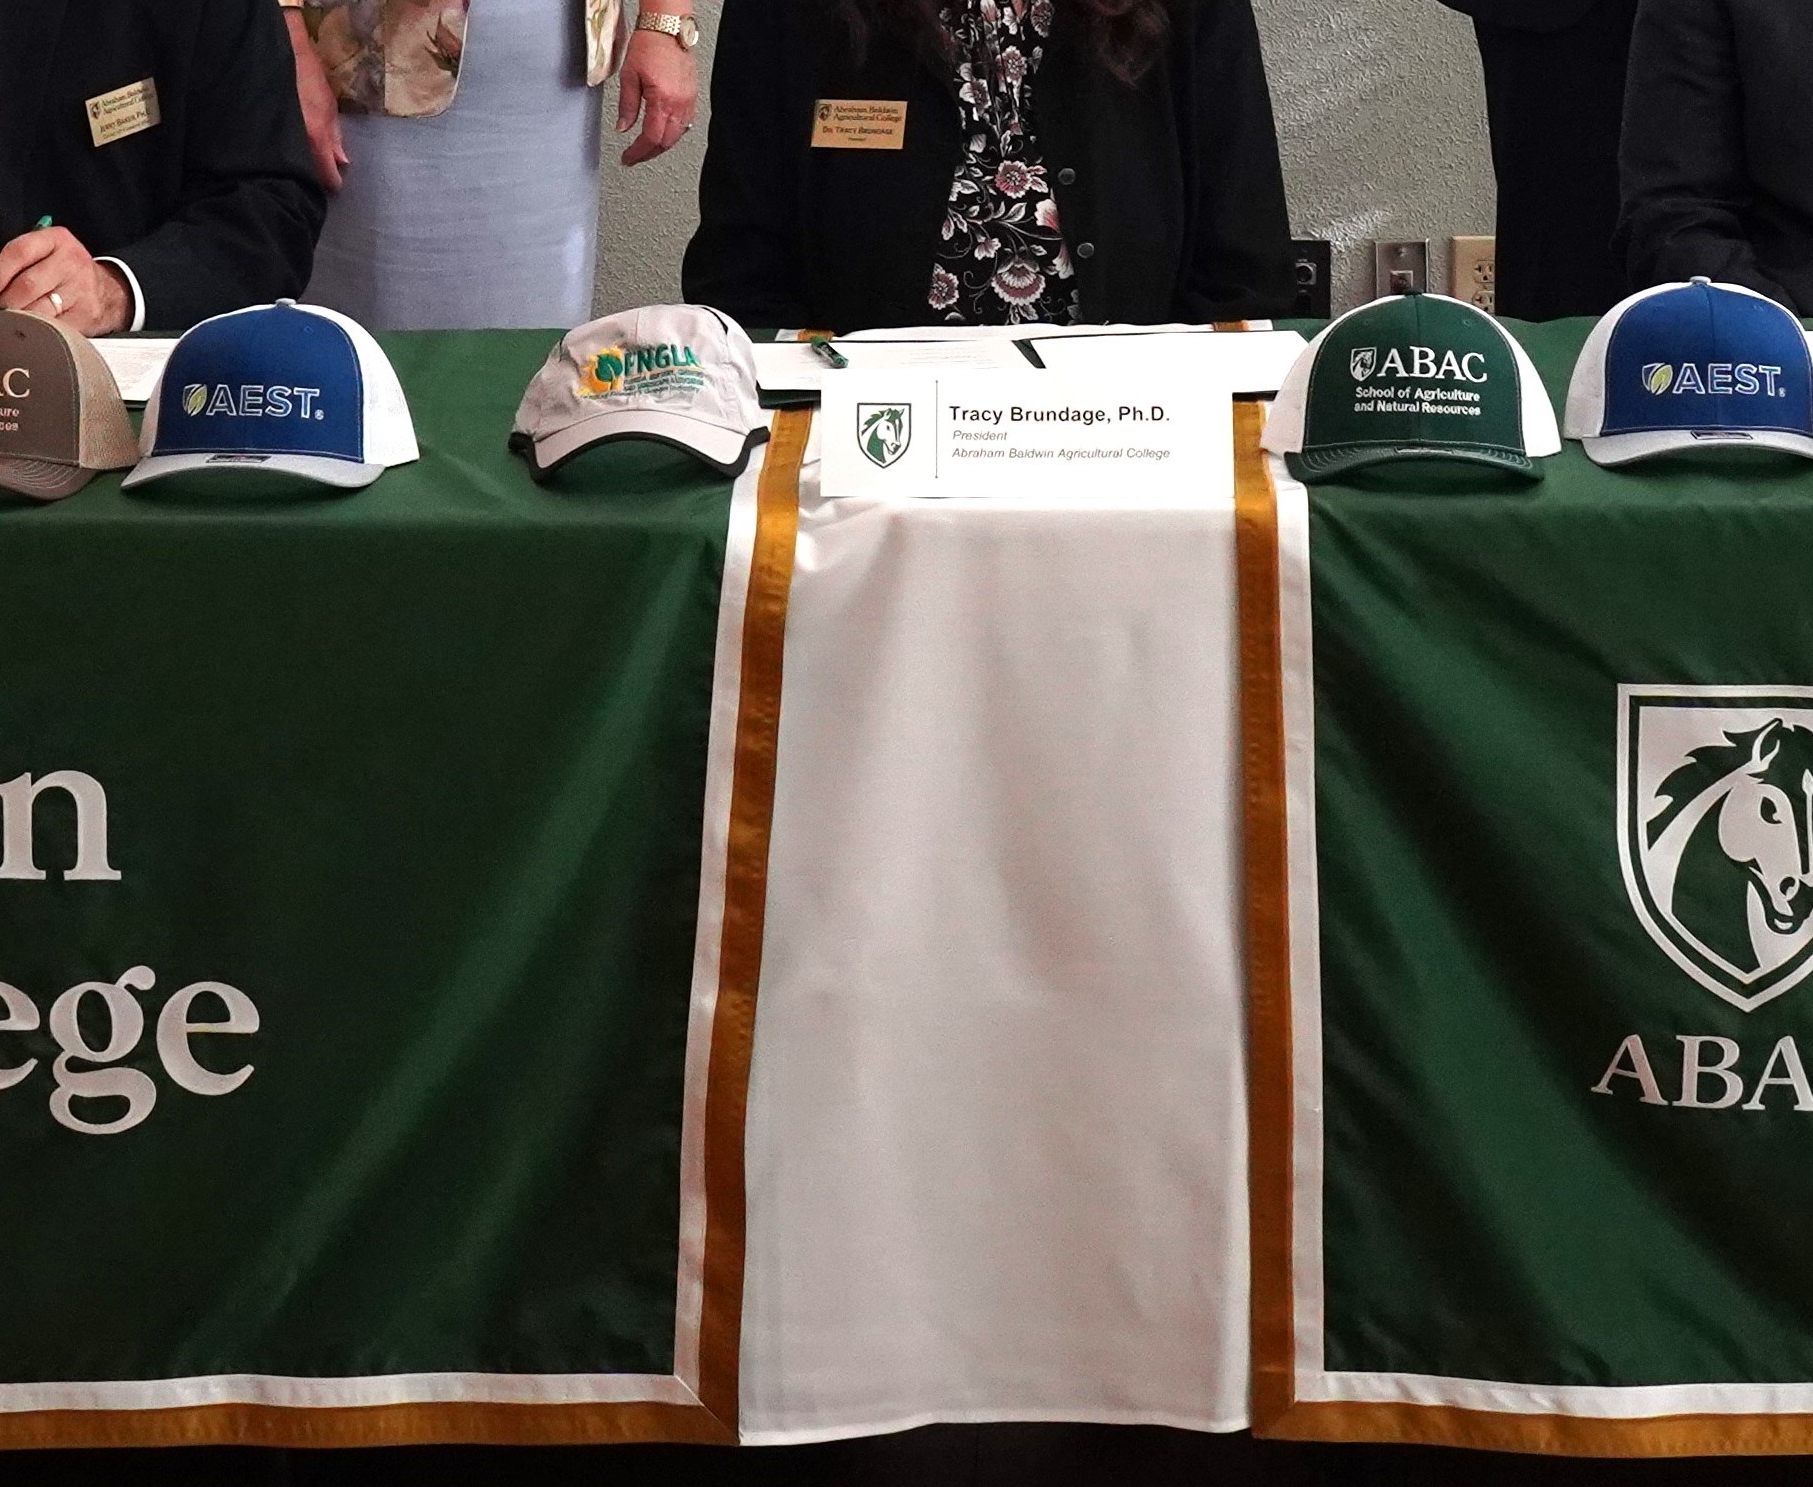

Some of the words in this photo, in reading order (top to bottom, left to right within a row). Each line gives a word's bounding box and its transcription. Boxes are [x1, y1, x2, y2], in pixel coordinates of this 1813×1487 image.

[1377, 345, 1487, 383] ABAC
[1355, 386, 1394, 399] School
[1398, 386, 1411, 398] of
[1414, 387, 1480, 402] Agriculture
[949, 406, 1003, 425] Tracy
[1011, 406, 1111, 426] Brundage,
[1119, 406, 1170, 422] Ph.D.
[1354, 401, 1374, 412] and
[1377, 400, 1419, 412] Natural
[1421, 401, 1481, 416] Resources
[952, 429, 1008, 441] President
[952, 448, 1005, 459] Abraham
[1009, 448, 1054, 459] Baldwin
[1057, 448, 1123, 461] Agricultural
[1126, 448, 1171, 461] College
